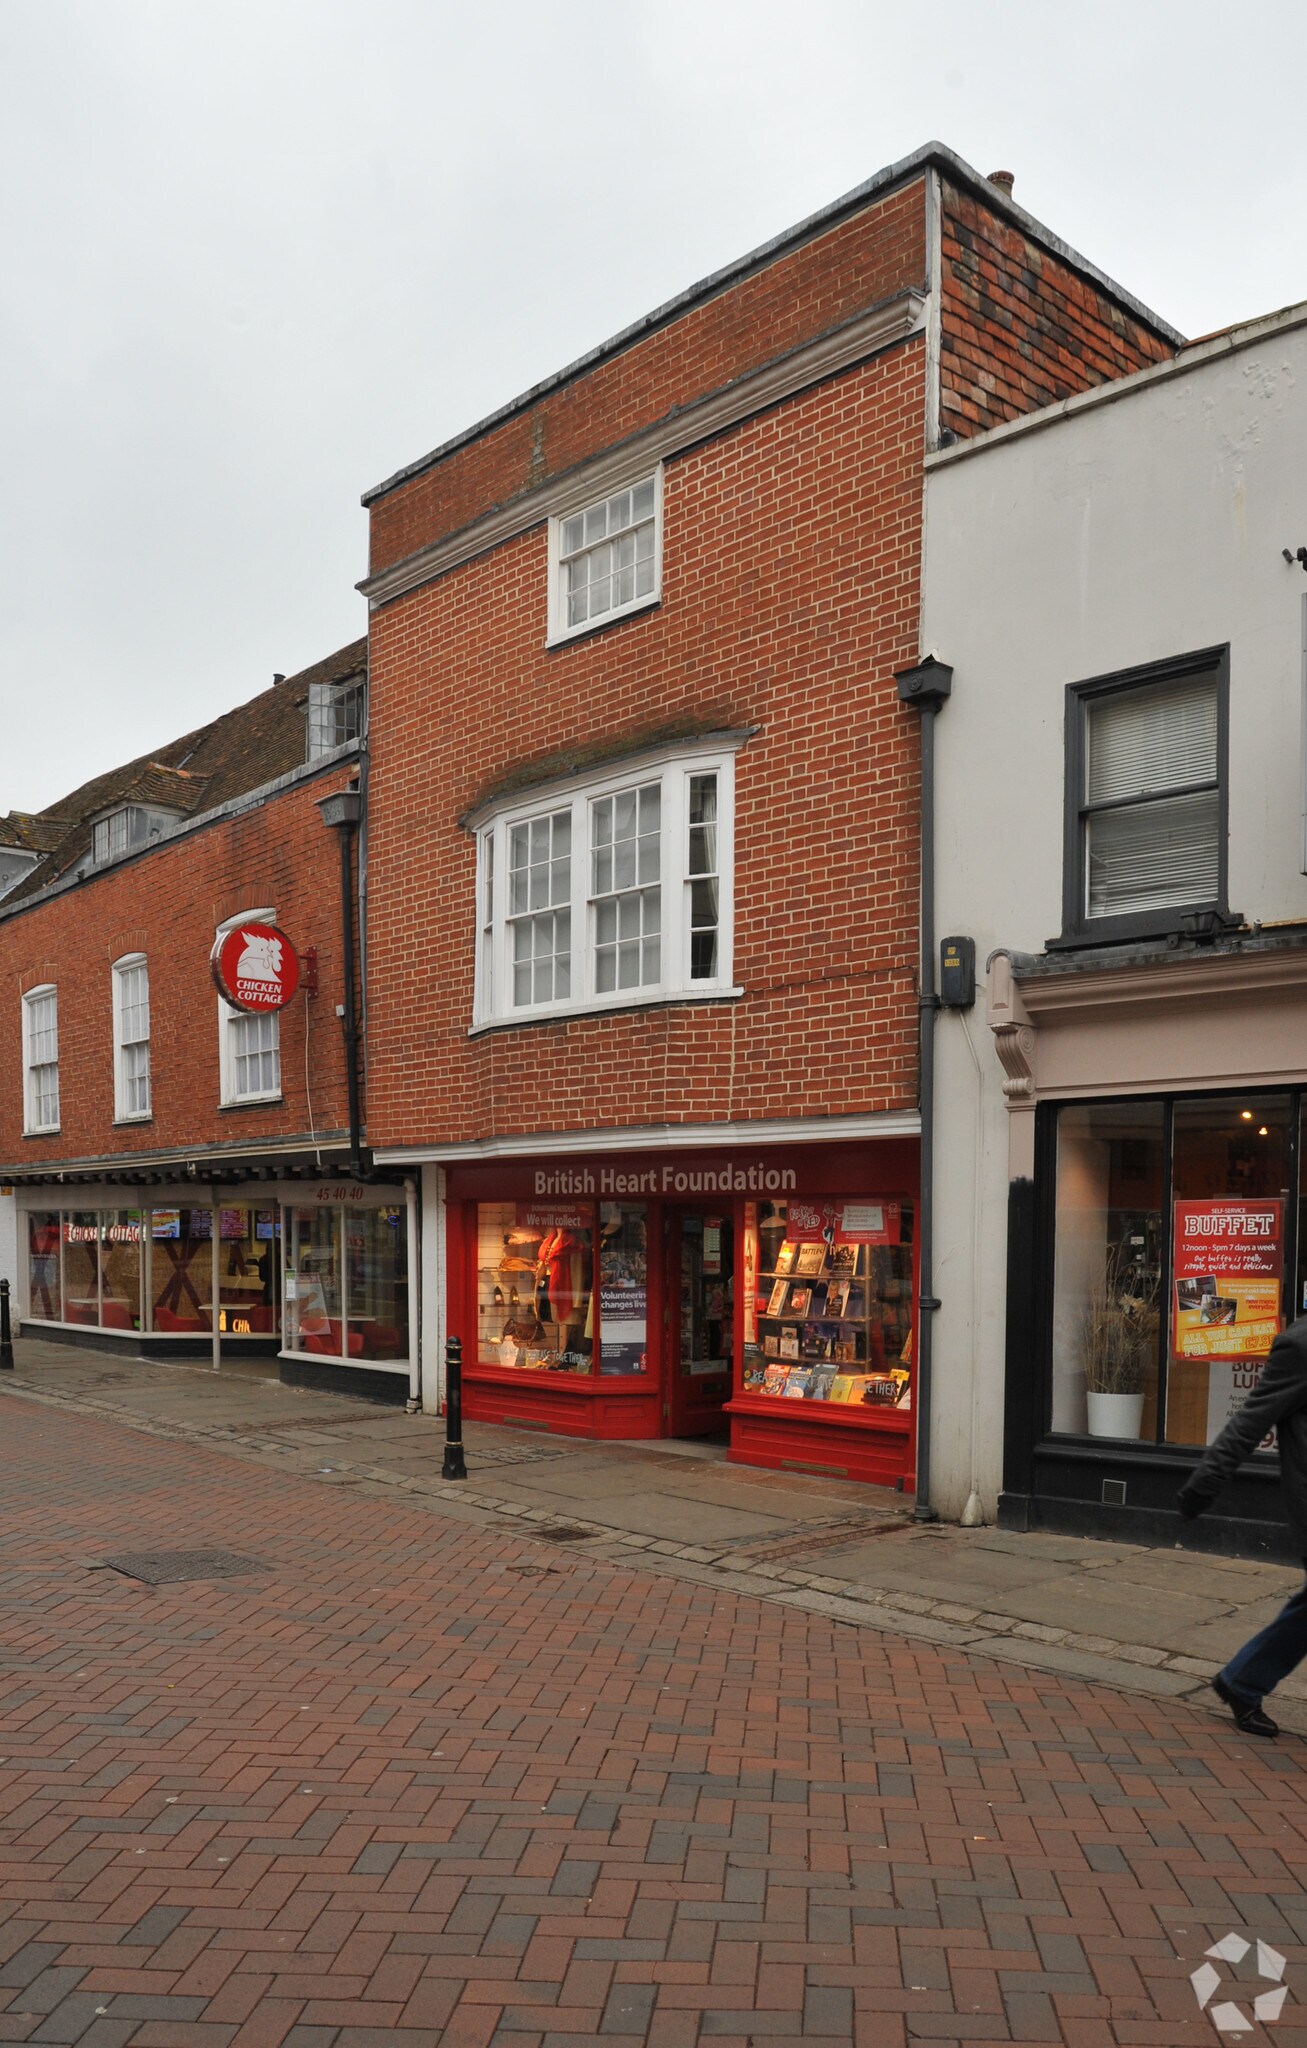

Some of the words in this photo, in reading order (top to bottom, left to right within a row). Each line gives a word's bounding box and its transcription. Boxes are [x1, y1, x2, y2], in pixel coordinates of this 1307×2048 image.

[236, 980, 282, 994] CHICKEN
[237, 990, 283, 1005] COTTAGE
[535, 1168, 595, 1194] British
[600, 1168, 657, 1193] Heart
[662, 1162, 796, 1191] Foundation
[316, 1187, 330, 1200] 45
[332, 1187, 346, 1200] 40
[349, 1186, 364, 1200] 40
[526, 1213, 540, 1225] We
[541, 1213, 554, 1226] will
[554, 1214, 581, 1226] collect
[1184, 1214, 1274, 1236] BUFFET
[1212, 1244, 1228, 1252] 5pm
[1234, 1243, 1251, 1252] days
[1257, 1243, 1277, 1251] week
[1194, 1254, 1207, 1262] Our
[1207, 1253, 1232, 1262] buffet
[1242, 1253, 1262, 1263] really
[1183, 1262, 1207, 1271] simple,
[1208, 1261, 1228, 1271] quick
[1242, 1261, 1273, 1271] delicious
[601, 1291, 646, 1300] Volunteerin
[601, 1300, 634, 1310] changes
[1184, 1333, 1205, 1345] ALL
[1206, 1329, 1227, 1341] YOU
[1229, 1325, 1251, 1337] CAN
[1252, 1322, 1276, 1335] EAT
[1184, 1343, 1208, 1357] FOR
[1211, 1338, 1243, 1354] JUST
